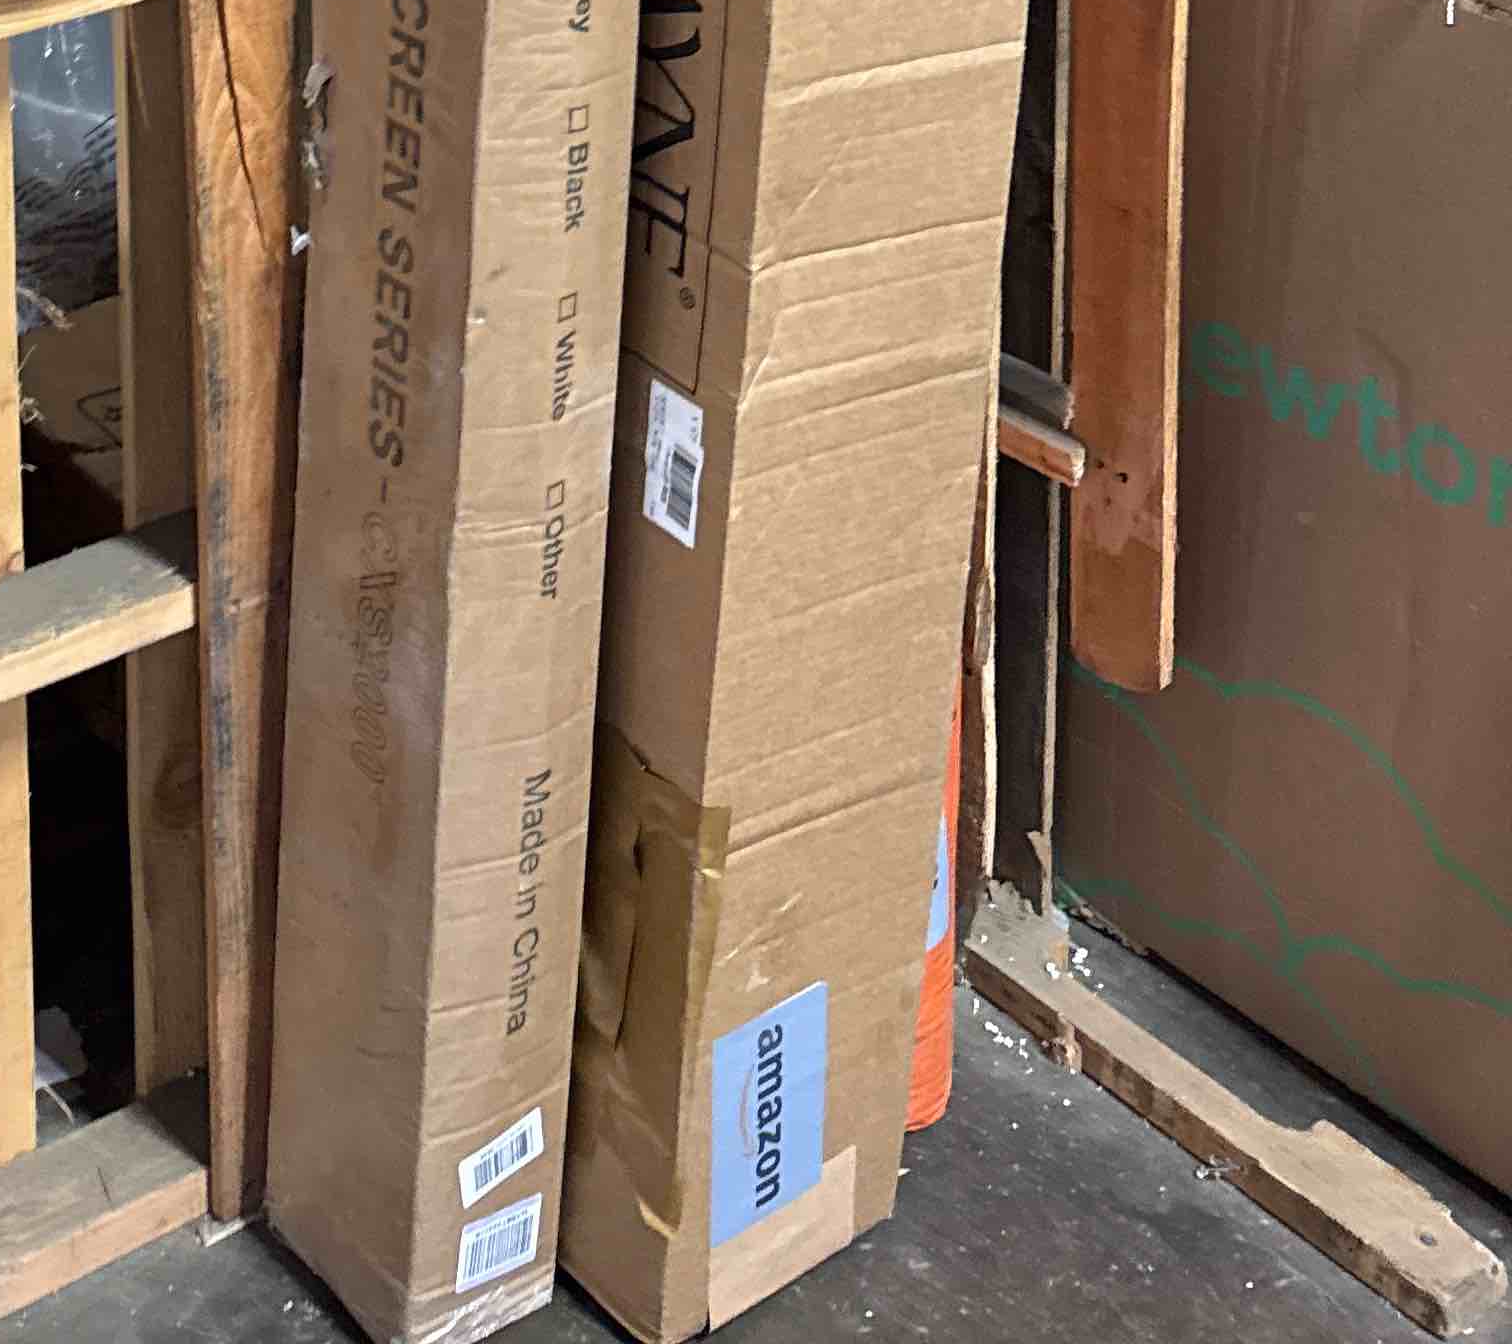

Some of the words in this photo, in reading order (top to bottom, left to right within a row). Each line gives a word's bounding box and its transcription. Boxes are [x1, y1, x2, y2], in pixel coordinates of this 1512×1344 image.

[564, 141, 590, 233] Black
[368, 227, 417, 469] SERIES
[552, 330, 578, 423] White
[1186, 320, 1512, 528] ewto
[539, 514, 566, 600] Other
[518, 768, 552, 874] Made
[515, 886, 538, 920] in
[505, 928, 541, 1038] China
[753, 1023, 784, 1210] amazon
